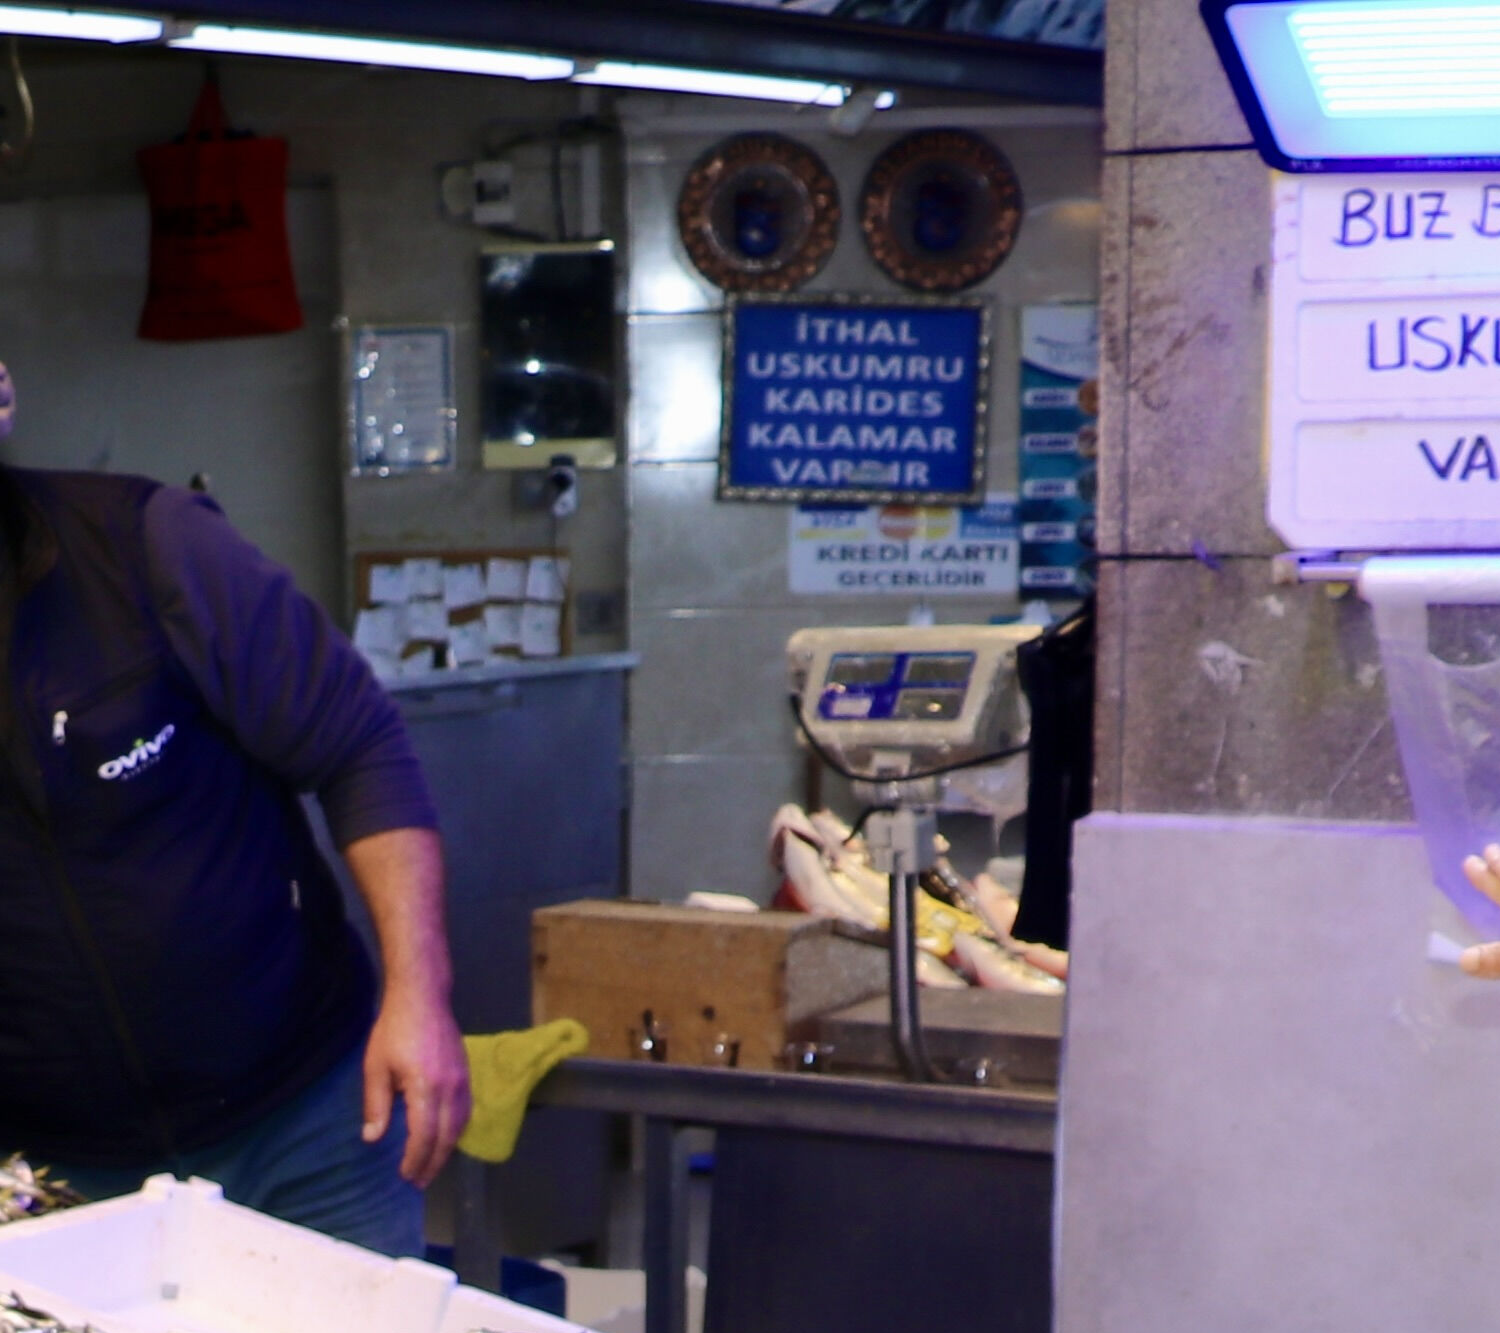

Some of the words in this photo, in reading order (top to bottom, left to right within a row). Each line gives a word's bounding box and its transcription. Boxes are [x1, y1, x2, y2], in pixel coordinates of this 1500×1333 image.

[1332, 187, 1454, 248] BUZ
[796, 313, 919, 345] İTHAL
[747, 353, 964, 383] USKUMRU
[764, 384, 945, 418] KARİDES
[748, 423, 957, 452] KALAMAR
